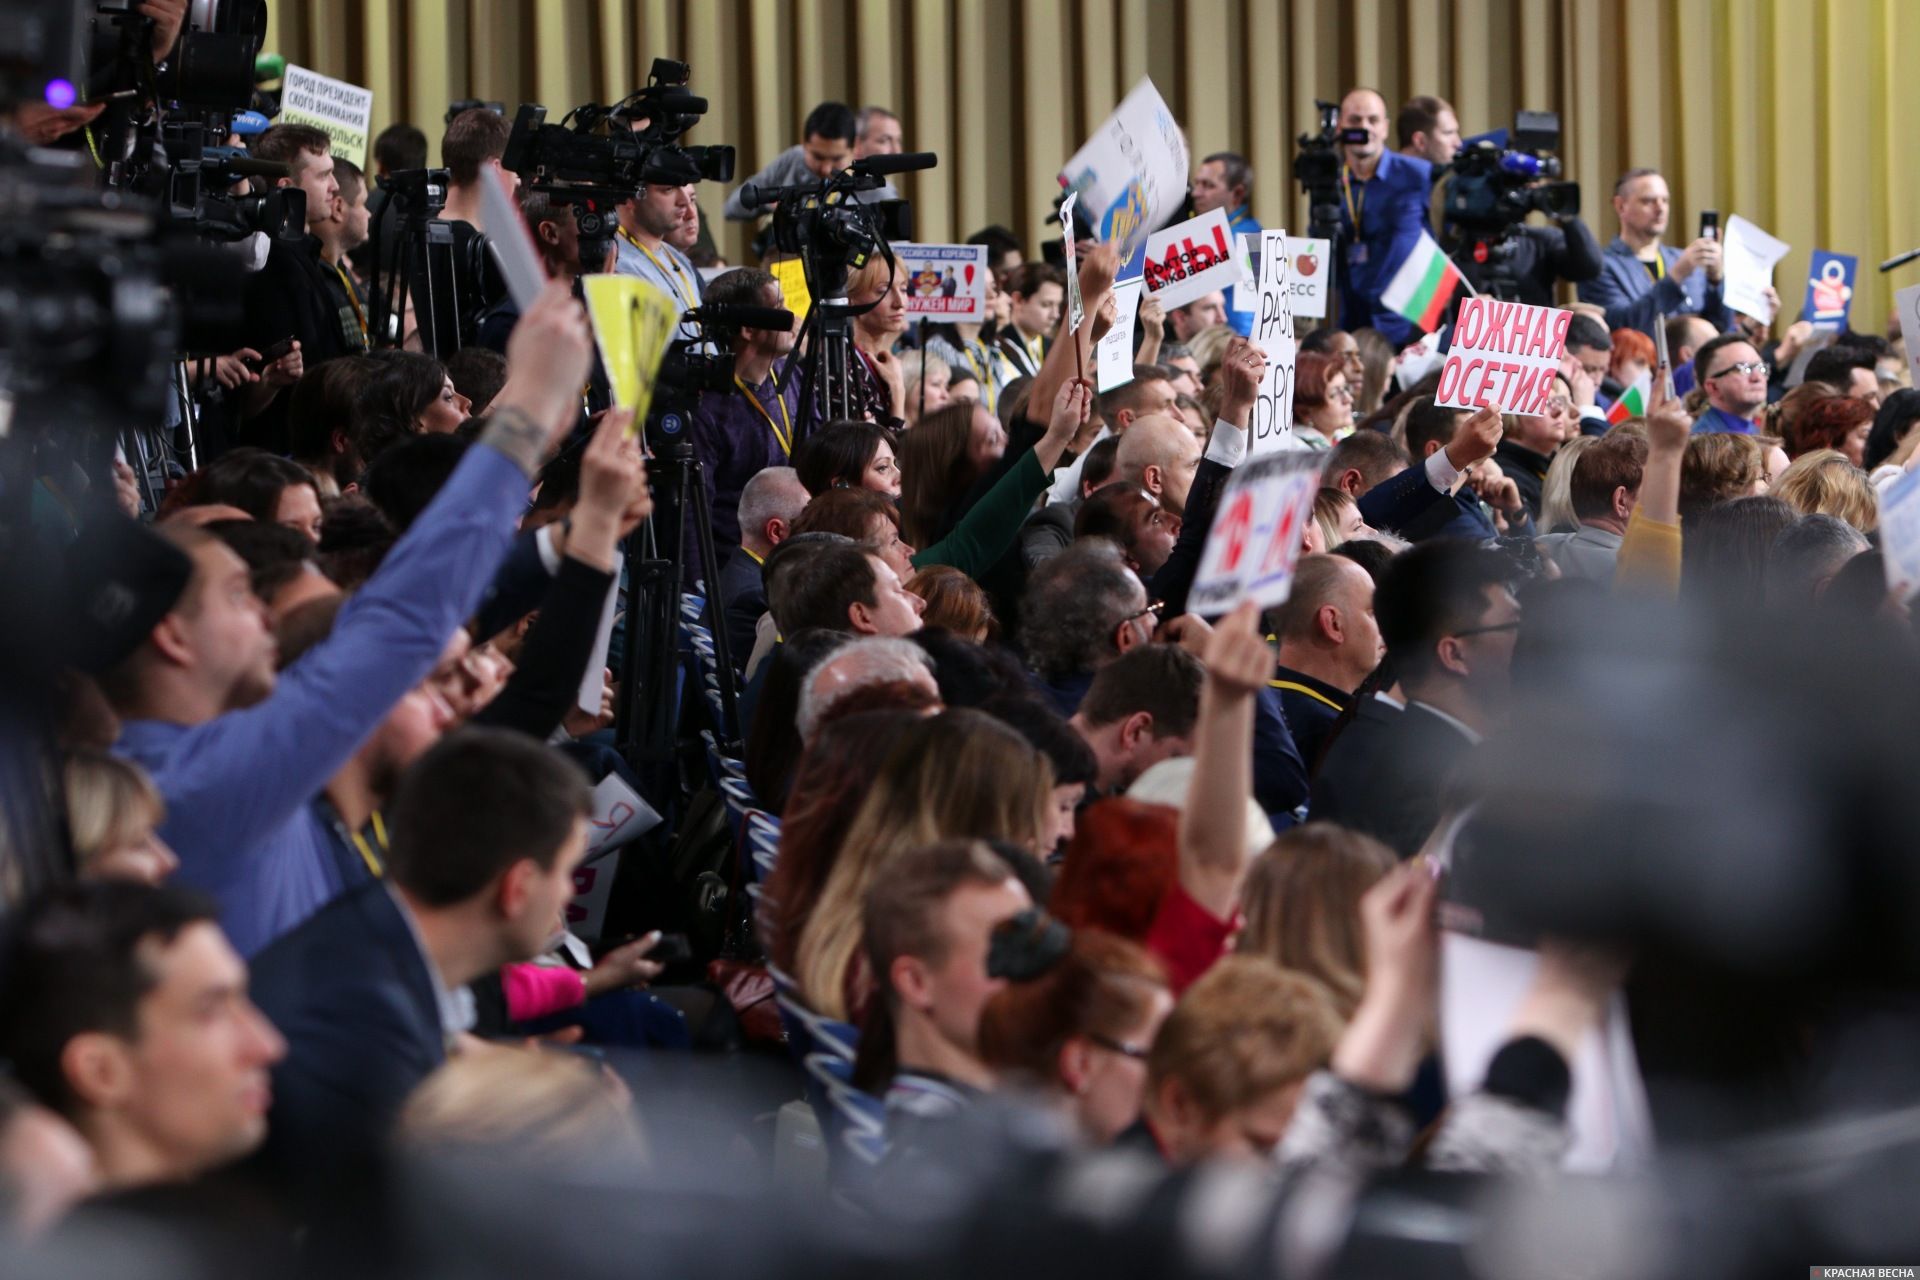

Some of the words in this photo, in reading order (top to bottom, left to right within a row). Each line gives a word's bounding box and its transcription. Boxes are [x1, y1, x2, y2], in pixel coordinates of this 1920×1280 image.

[288, 72, 316, 94] ГОРОД
[288, 91, 315, 111] СКОГО
[316, 102, 364, 126] ВНИМАНИЯ
[1144, 249, 1199, 280] ДОКТОР
[1147, 250, 1230, 293] БЫКОВСКАЯ
[948, 299, 971, 312] МИР
[1451, 297, 1574, 360] ЮЖНАЯ
[1438, 355, 1557, 414] ОСЕТИЯ
